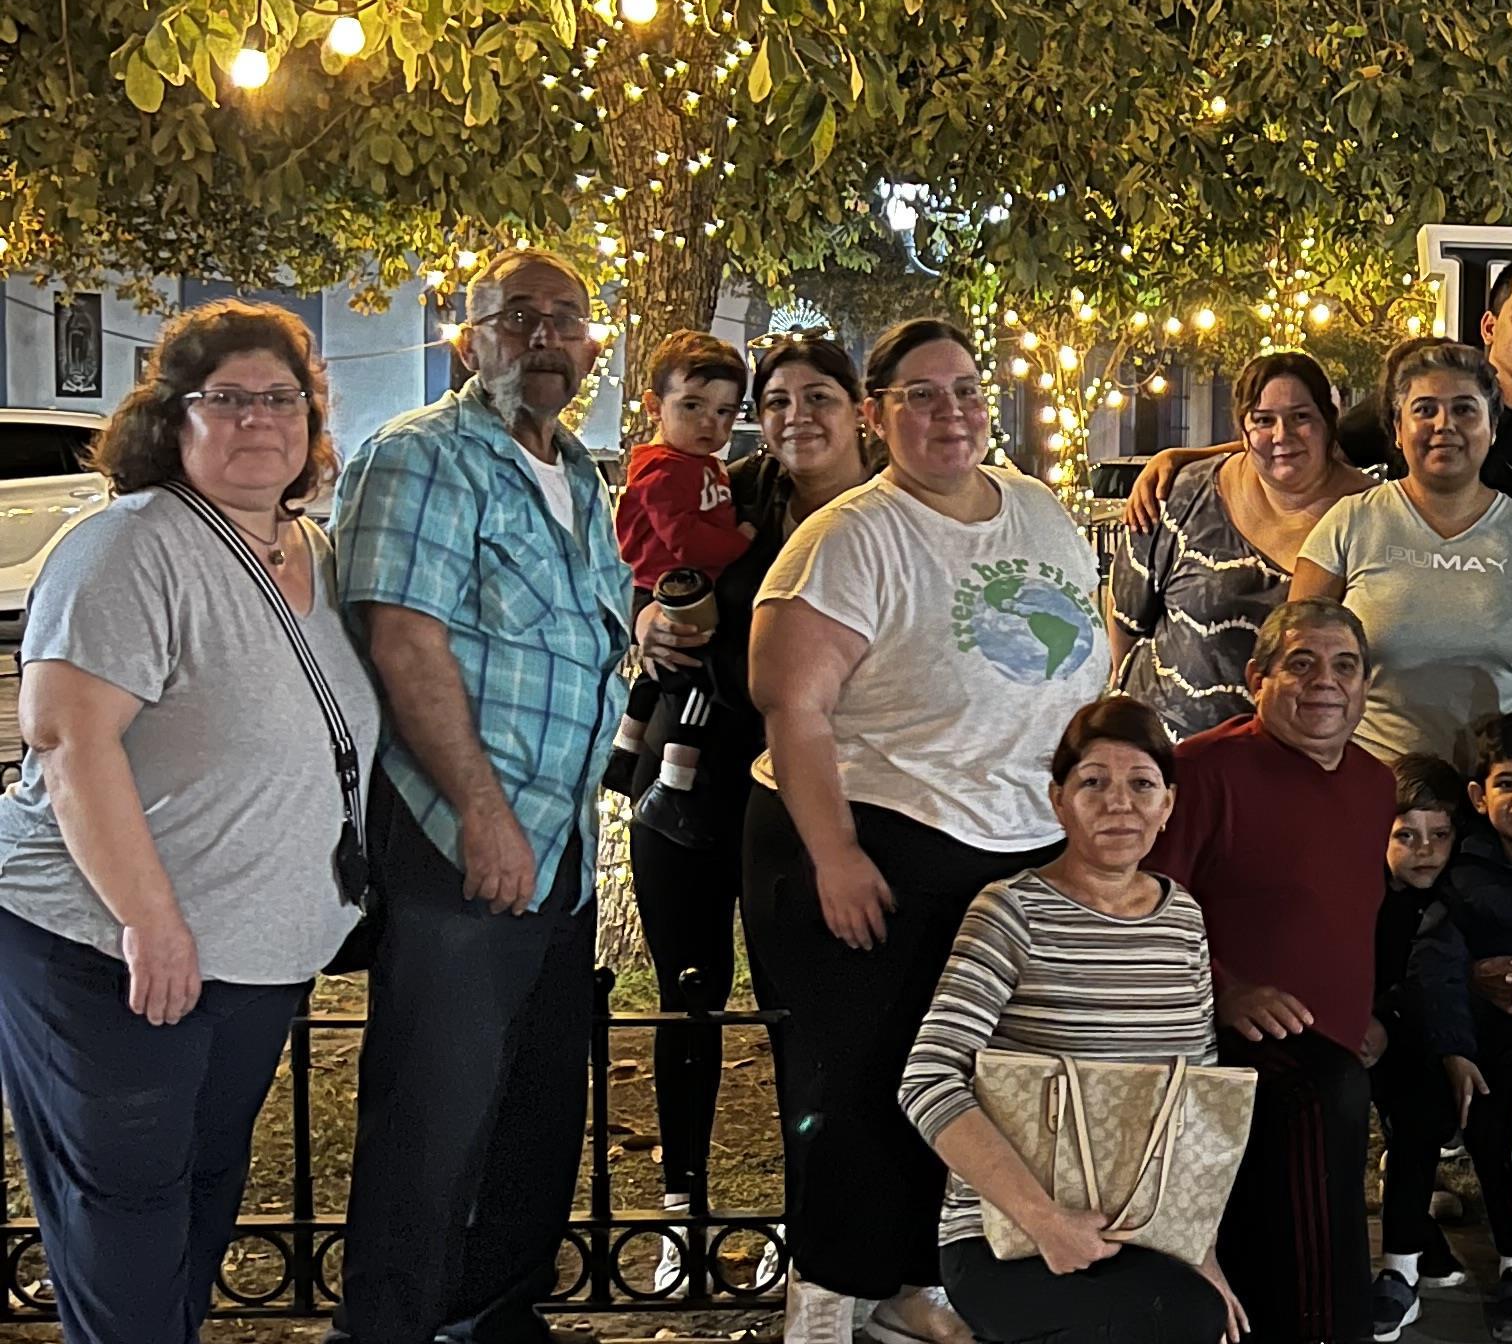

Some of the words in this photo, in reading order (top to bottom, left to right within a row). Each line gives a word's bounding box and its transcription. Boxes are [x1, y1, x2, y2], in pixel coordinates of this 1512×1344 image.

[1386, 544, 1487, 573] PUMA
[951, 578, 983, 653] treat
[971, 558, 1029, 582] her
